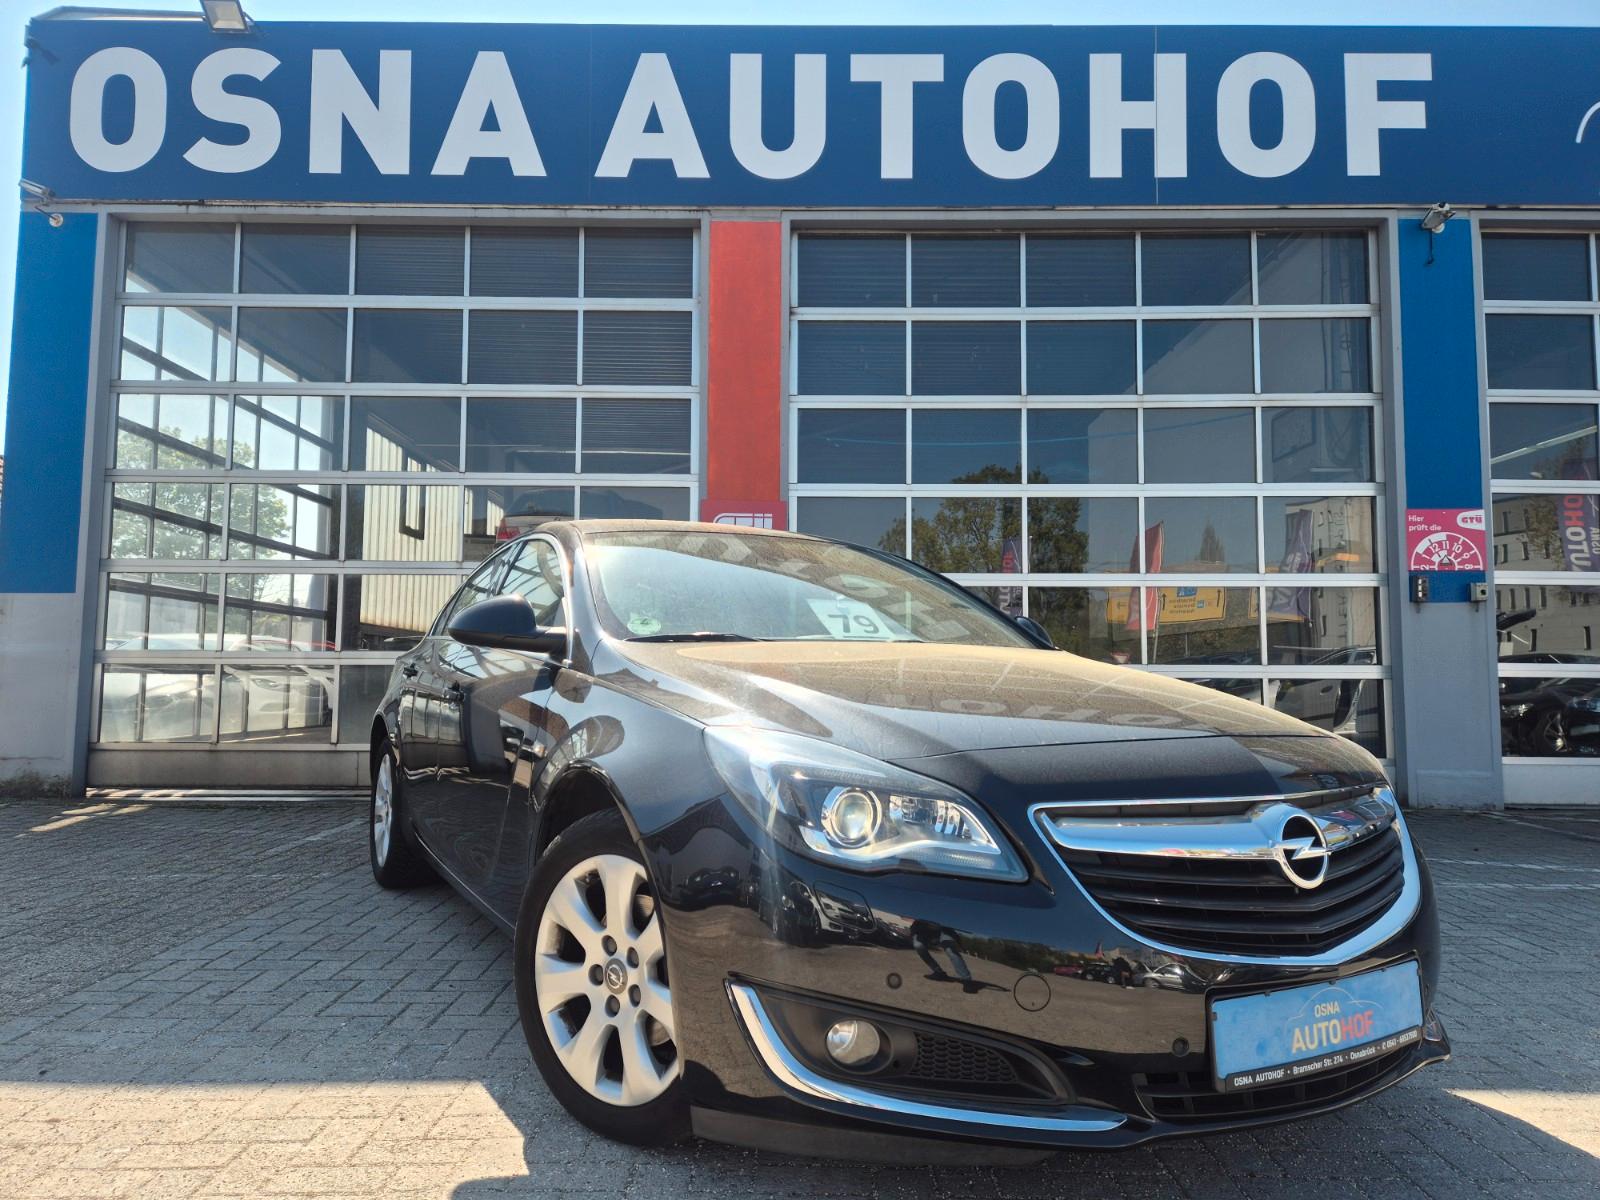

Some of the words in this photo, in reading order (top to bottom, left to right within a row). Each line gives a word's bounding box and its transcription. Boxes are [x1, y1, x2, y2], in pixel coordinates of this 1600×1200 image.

[69, 46, 547, 177] OSNA
[593, 51, 1433, 180] AUTOHOF
[1408, 514, 1424, 522] Hier
[1408, 524, 1429, 532] prüft
[1429, 523, 1442, 531] die
[1461, 514, 1483, 524] GTÜ
[1429, 543, 1440, 553] 12
[1442, 540, 1450, 550] 11
[1452, 542, 1463, 553] 10
[827, 613, 880, 634] 79
[1314, 1000, 1340, 1019] OSNA
[1291, 1010, 1375, 1054] AUTOHOF
[1234, 1075, 1253, 1087] OSNA
[1255, 1069, 1285, 1082] AUTOHOF
[1292, 1061, 1323, 1076] Bramscher
[1350, 1047, 1376, 1061] Osnabrück
